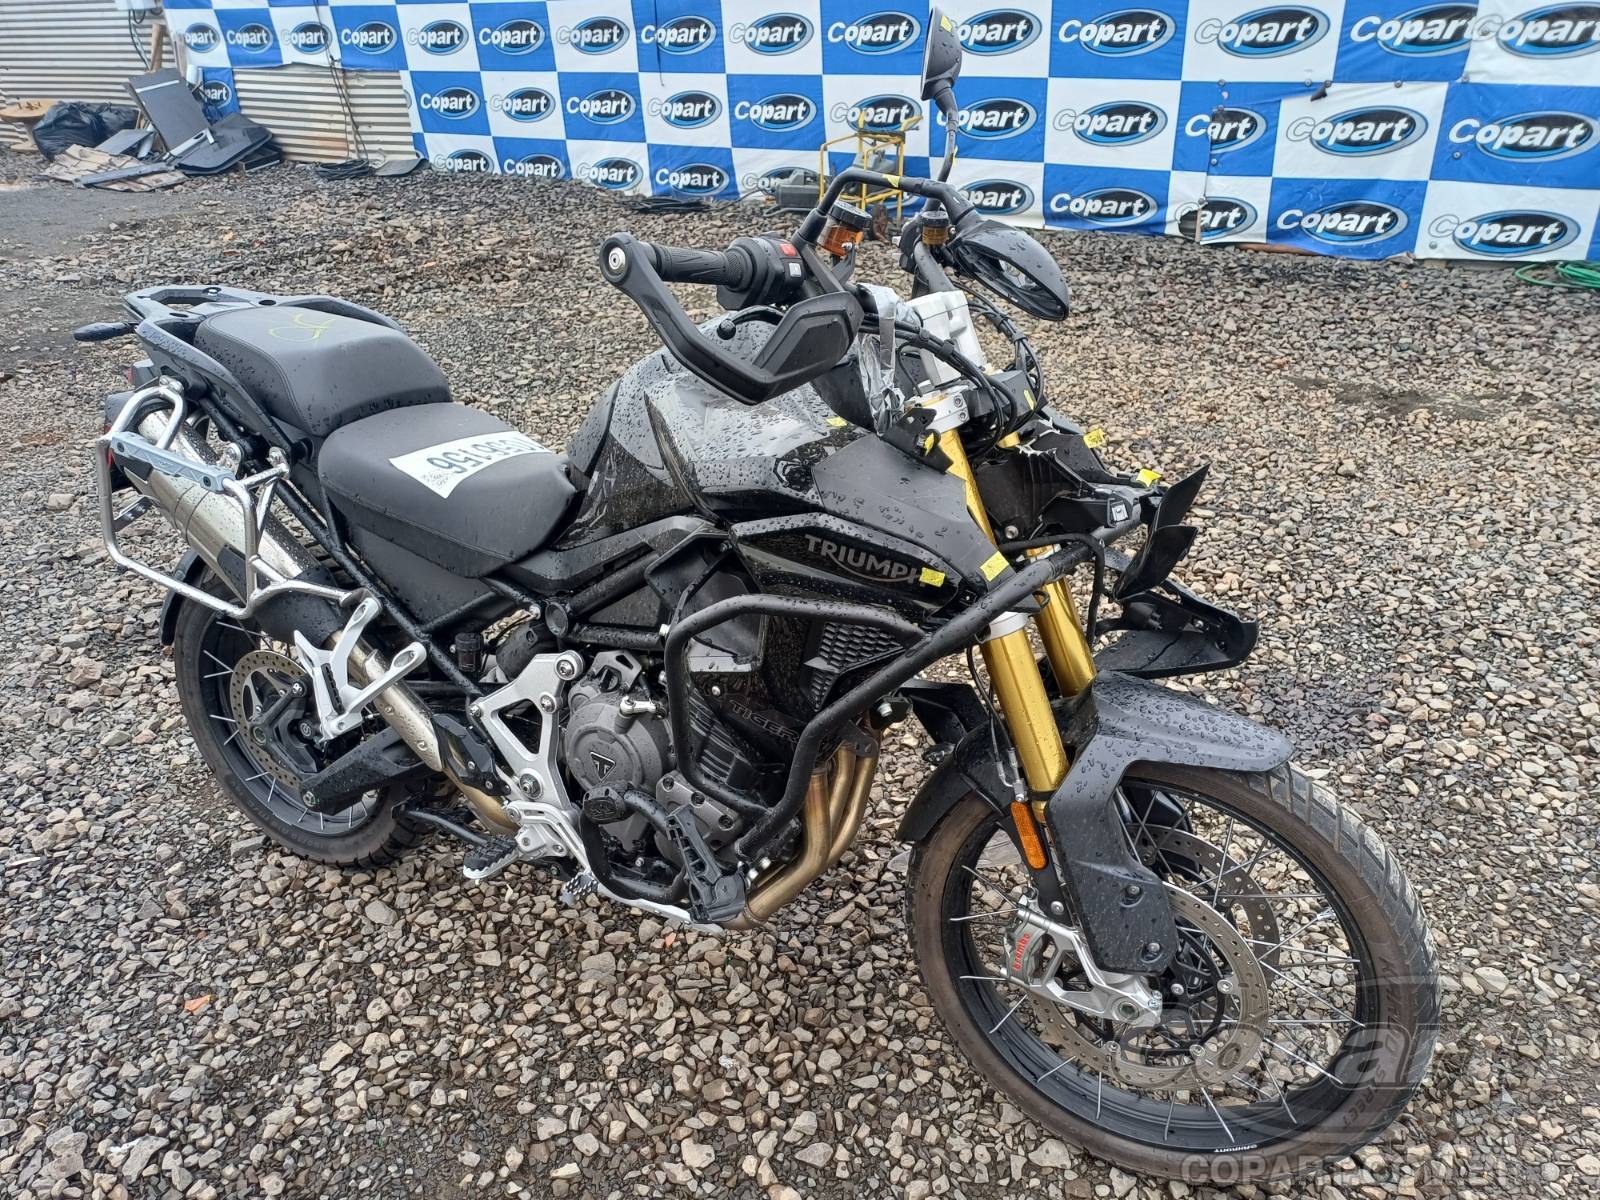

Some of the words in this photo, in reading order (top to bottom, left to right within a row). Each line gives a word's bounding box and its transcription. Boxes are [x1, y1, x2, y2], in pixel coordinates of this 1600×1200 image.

[177, 30, 214, 46] opart
[227, 30, 268, 47] Copart
[282, 29, 325, 47] Copart
[342, 28, 390, 47] Copart
[407, 27, 461, 48] Copart
[479, 27, 536, 48] Copart
[556, 26, 619, 47] Copart
[641, 23, 707, 46] Copart
[730, 21, 802, 46] Copart
[828, 20, 909, 46] Copart
[953, 19, 1027, 45] opart
[1058, 18, 1162, 46] Copart
[1195, 15, 1312, 50] Copart
[204, 86, 227, 101] part
[420, 93, 473, 113] Copart
[490, 94, 547, 115] Copart
[567, 96, 628, 117] Copart
[649, 98, 712, 120] Copart
[735, 101, 807, 123] Copart
[831, 103, 910, 126] Copart
[1053, 107, 1151, 136] Copart
[1287, 115, 1410, 147] Copart
[1449, 118, 1586, 150] Copart
[433, 153, 487, 172] Copart
[504, 158, 557, 177] Copart
[576, 162, 634, 183] Copart
[656, 168, 720, 188] Copart
[1051, 192, 1146, 216] Copart
[1277, 208, 1389, 233] Copart
[1429, 214, 1560, 245] Copart
[730, 700, 799, 743] TIGER
[1012, 933, 1031, 971] brembo
